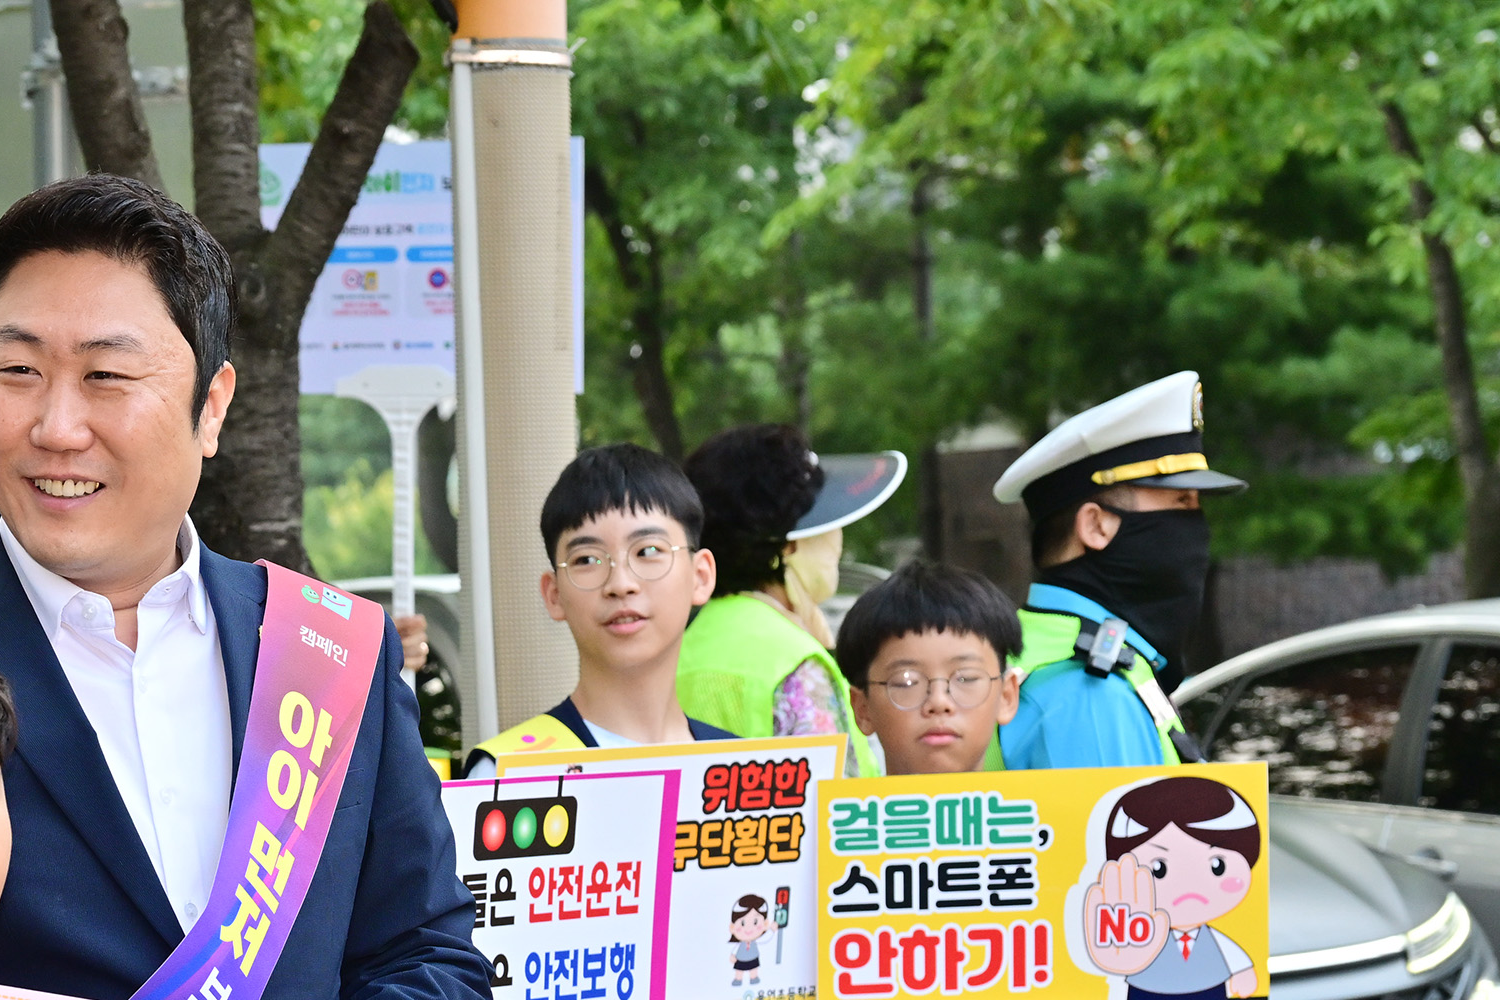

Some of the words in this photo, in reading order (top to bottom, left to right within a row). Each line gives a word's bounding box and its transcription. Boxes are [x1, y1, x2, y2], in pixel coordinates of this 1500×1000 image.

[300, 625, 348, 667] 캠페인
[267, 690, 334, 831] 아이
[703, 758, 810, 814] 위험한
[673, 812, 805, 872] 무단횡단
[831, 796, 1050, 852] 걸을때는,
[220, 820, 295, 978] 먼저
[462, 867, 516, 929] 들은
[528, 861, 641, 923] 안전운전
[832, 857, 1036, 913] 스마트폰
[1099, 907, 1150, 943] No
[833, 924, 1049, 995] 안하기!
